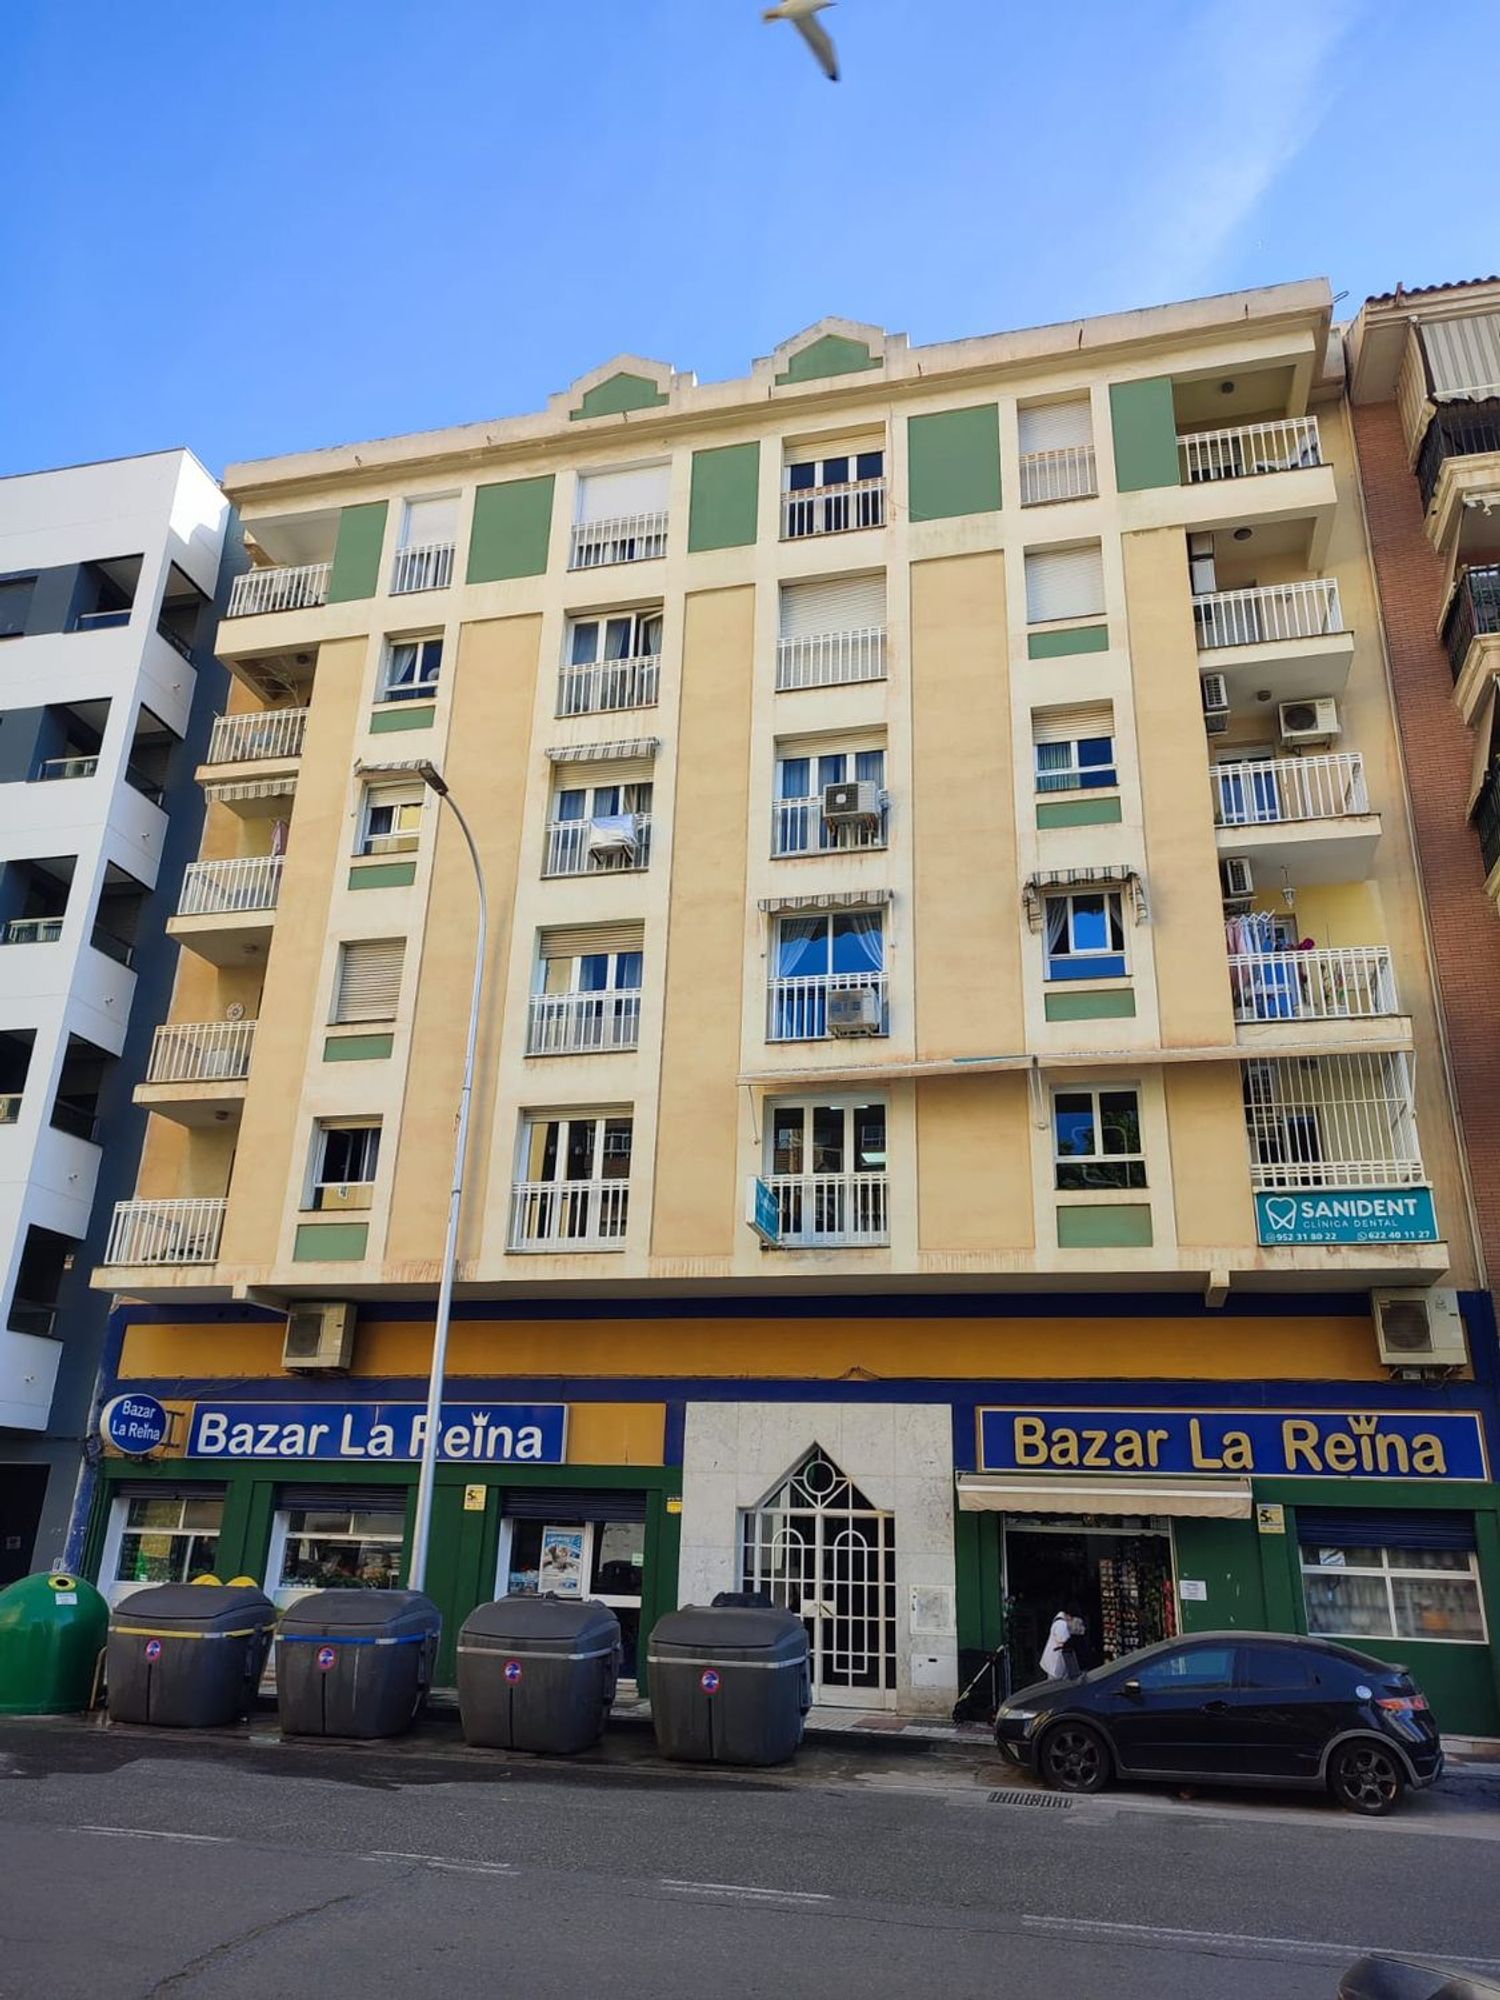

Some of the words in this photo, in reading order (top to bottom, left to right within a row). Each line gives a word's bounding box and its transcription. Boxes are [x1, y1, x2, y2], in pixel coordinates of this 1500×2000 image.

[1301, 1199, 1417, 1218] SANIDENT
[1353, 1219, 1399, 1228] DENTAL
[1325, 1232, 1337, 1240] 22
[1368, 1231, 1386, 1239] 622
[1388, 1231, 1401, 1239] 40
[1404, 1230, 1415, 1238] 11
[1418, 1230, 1430, 1238] 27
[122, 1400, 156, 1419] Bazar
[112, 1420, 127, 1436] La
[128, 1422, 160, 1441] Reina
[197, 1412, 330, 1455] Bazar
[340, 1413, 394, 1457] La
[409, 1412, 543, 1459] Reina
[1013, 1416, 1169, 1468] Bazar
[1189, 1418, 1254, 1471] La
[1282, 1416, 1447, 1475] Reina
